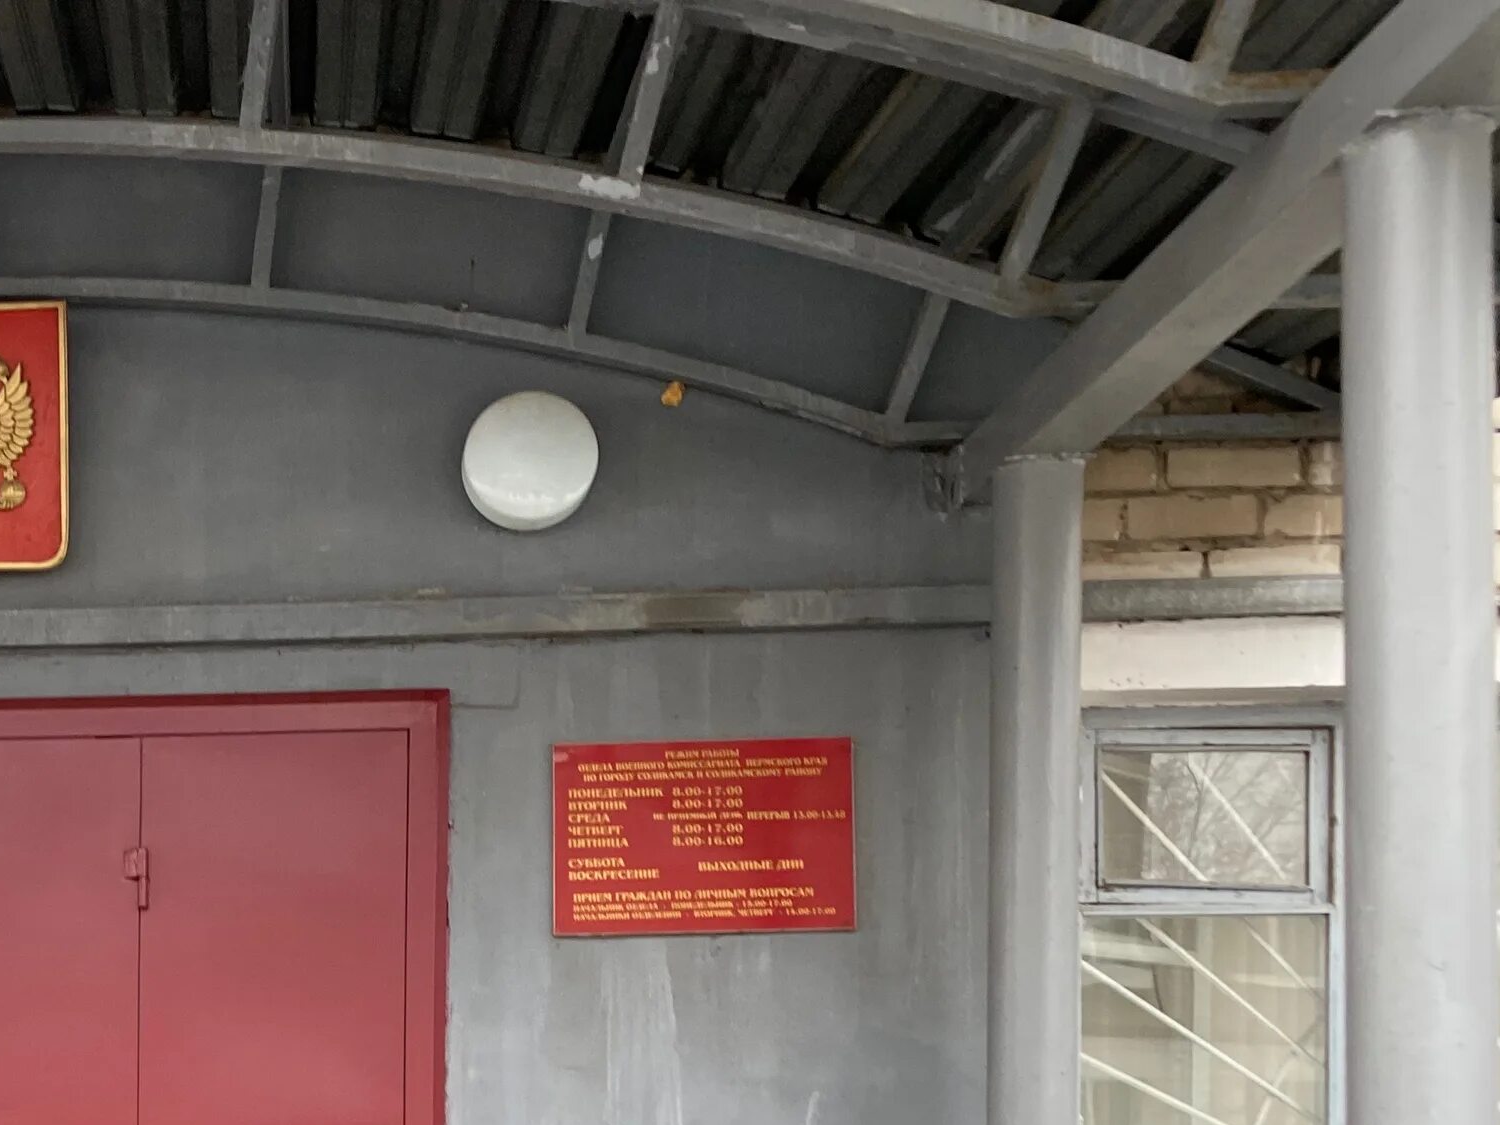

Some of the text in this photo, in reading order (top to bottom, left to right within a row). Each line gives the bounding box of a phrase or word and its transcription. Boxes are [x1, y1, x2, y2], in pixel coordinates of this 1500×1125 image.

[665, 750, 699, 760] РЕЖИМ
[615, 761, 665, 771] ВОЕННОГО
[568, 786, 743, 799] ПОНЕДЕЛЬНИК 8.00-17.00
[568, 798, 744, 811] ВТОРНИК 8.00-17.00
[568, 813, 610, 823] СРЕДА
[747, 810, 790, 820] ПЕРЕРЫВ
[568, 823, 744, 836] ЧЕТВЕРГ 8.00-17.00
[568, 837, 629, 848] ПЯТНИЦА
[568, 857, 625, 869] СУББОТА
[698, 859, 804, 872] ВЫХОДНЫЕ ДНИ
[568, 869, 660, 881] ВОСКРЕСЕНИЕ
[573, 886, 815, 903] ПРИЕМ ГРАЖДАН ПО ЛИЧНЫМ ВОПРОСАМ
